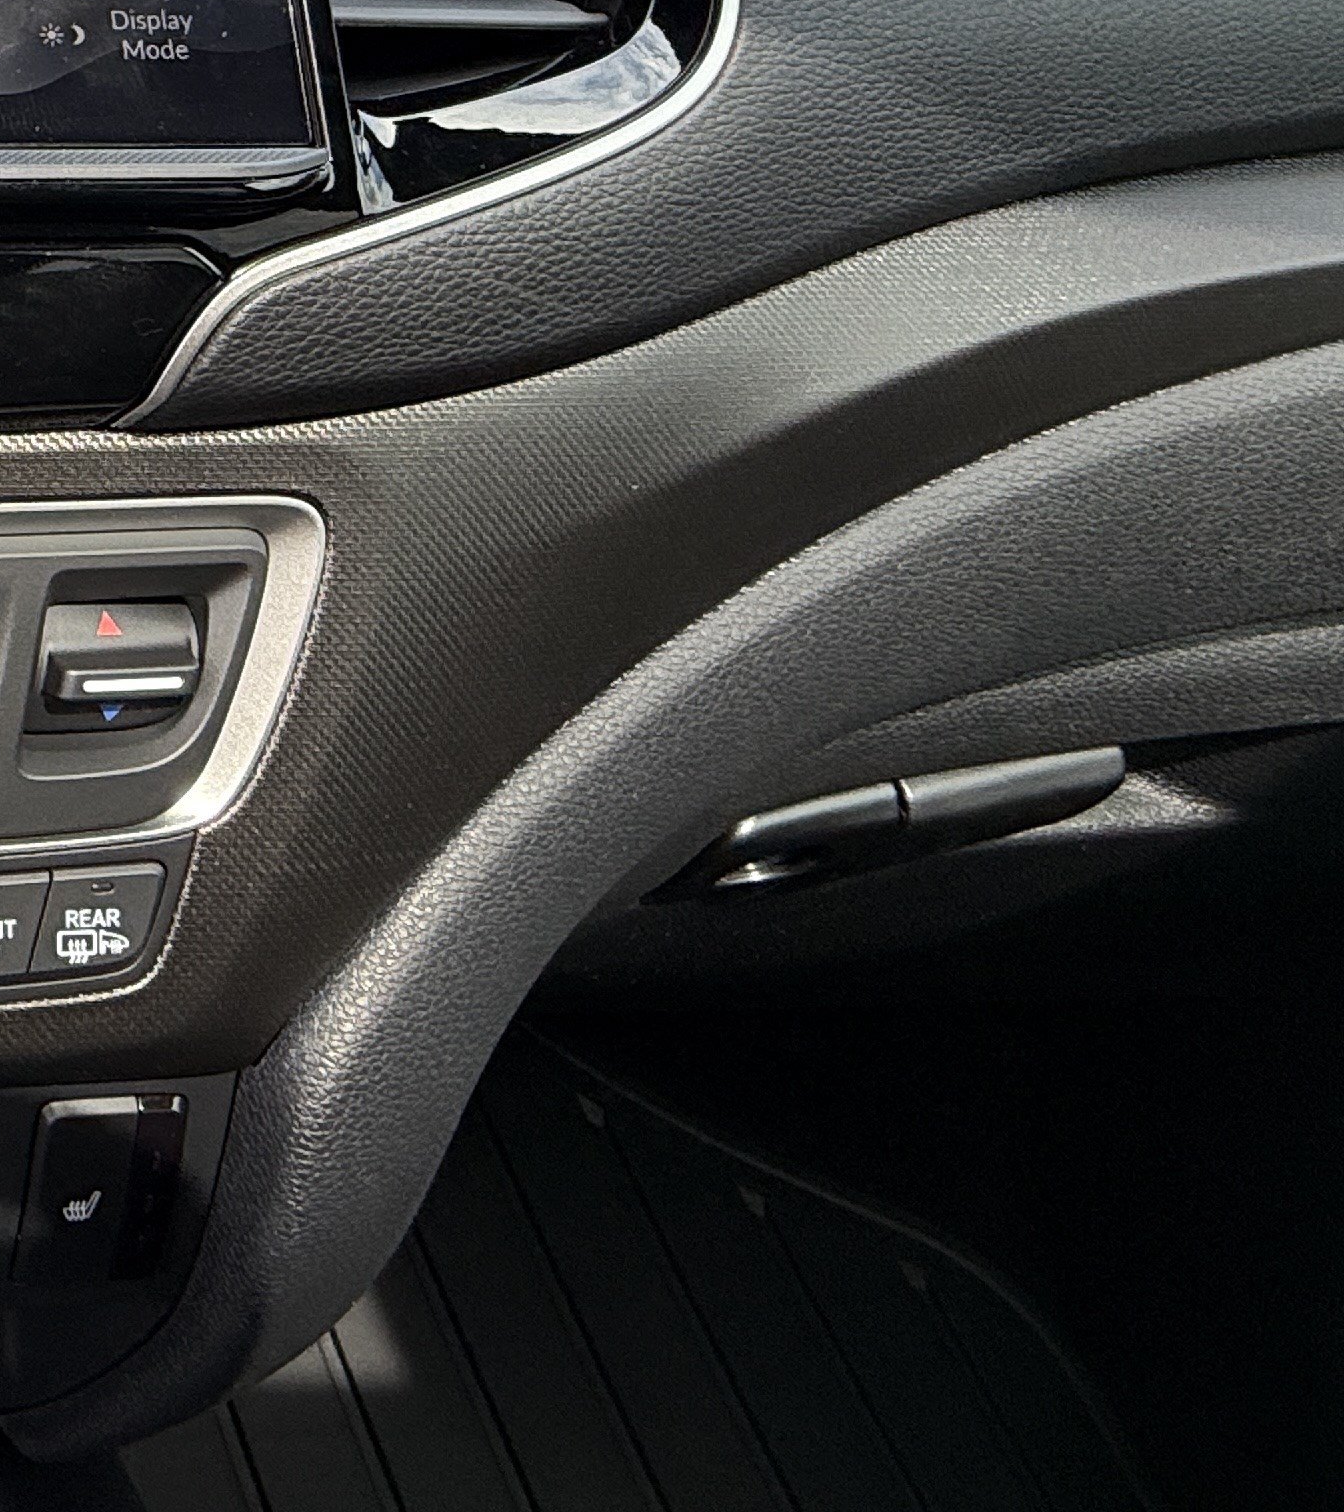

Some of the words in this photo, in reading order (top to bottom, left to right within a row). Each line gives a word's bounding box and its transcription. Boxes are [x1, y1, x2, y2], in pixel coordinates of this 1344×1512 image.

[110, 10, 193, 39] Display
[121, 38, 189, 60] Mode
[64, 907, 121, 931] REAR
